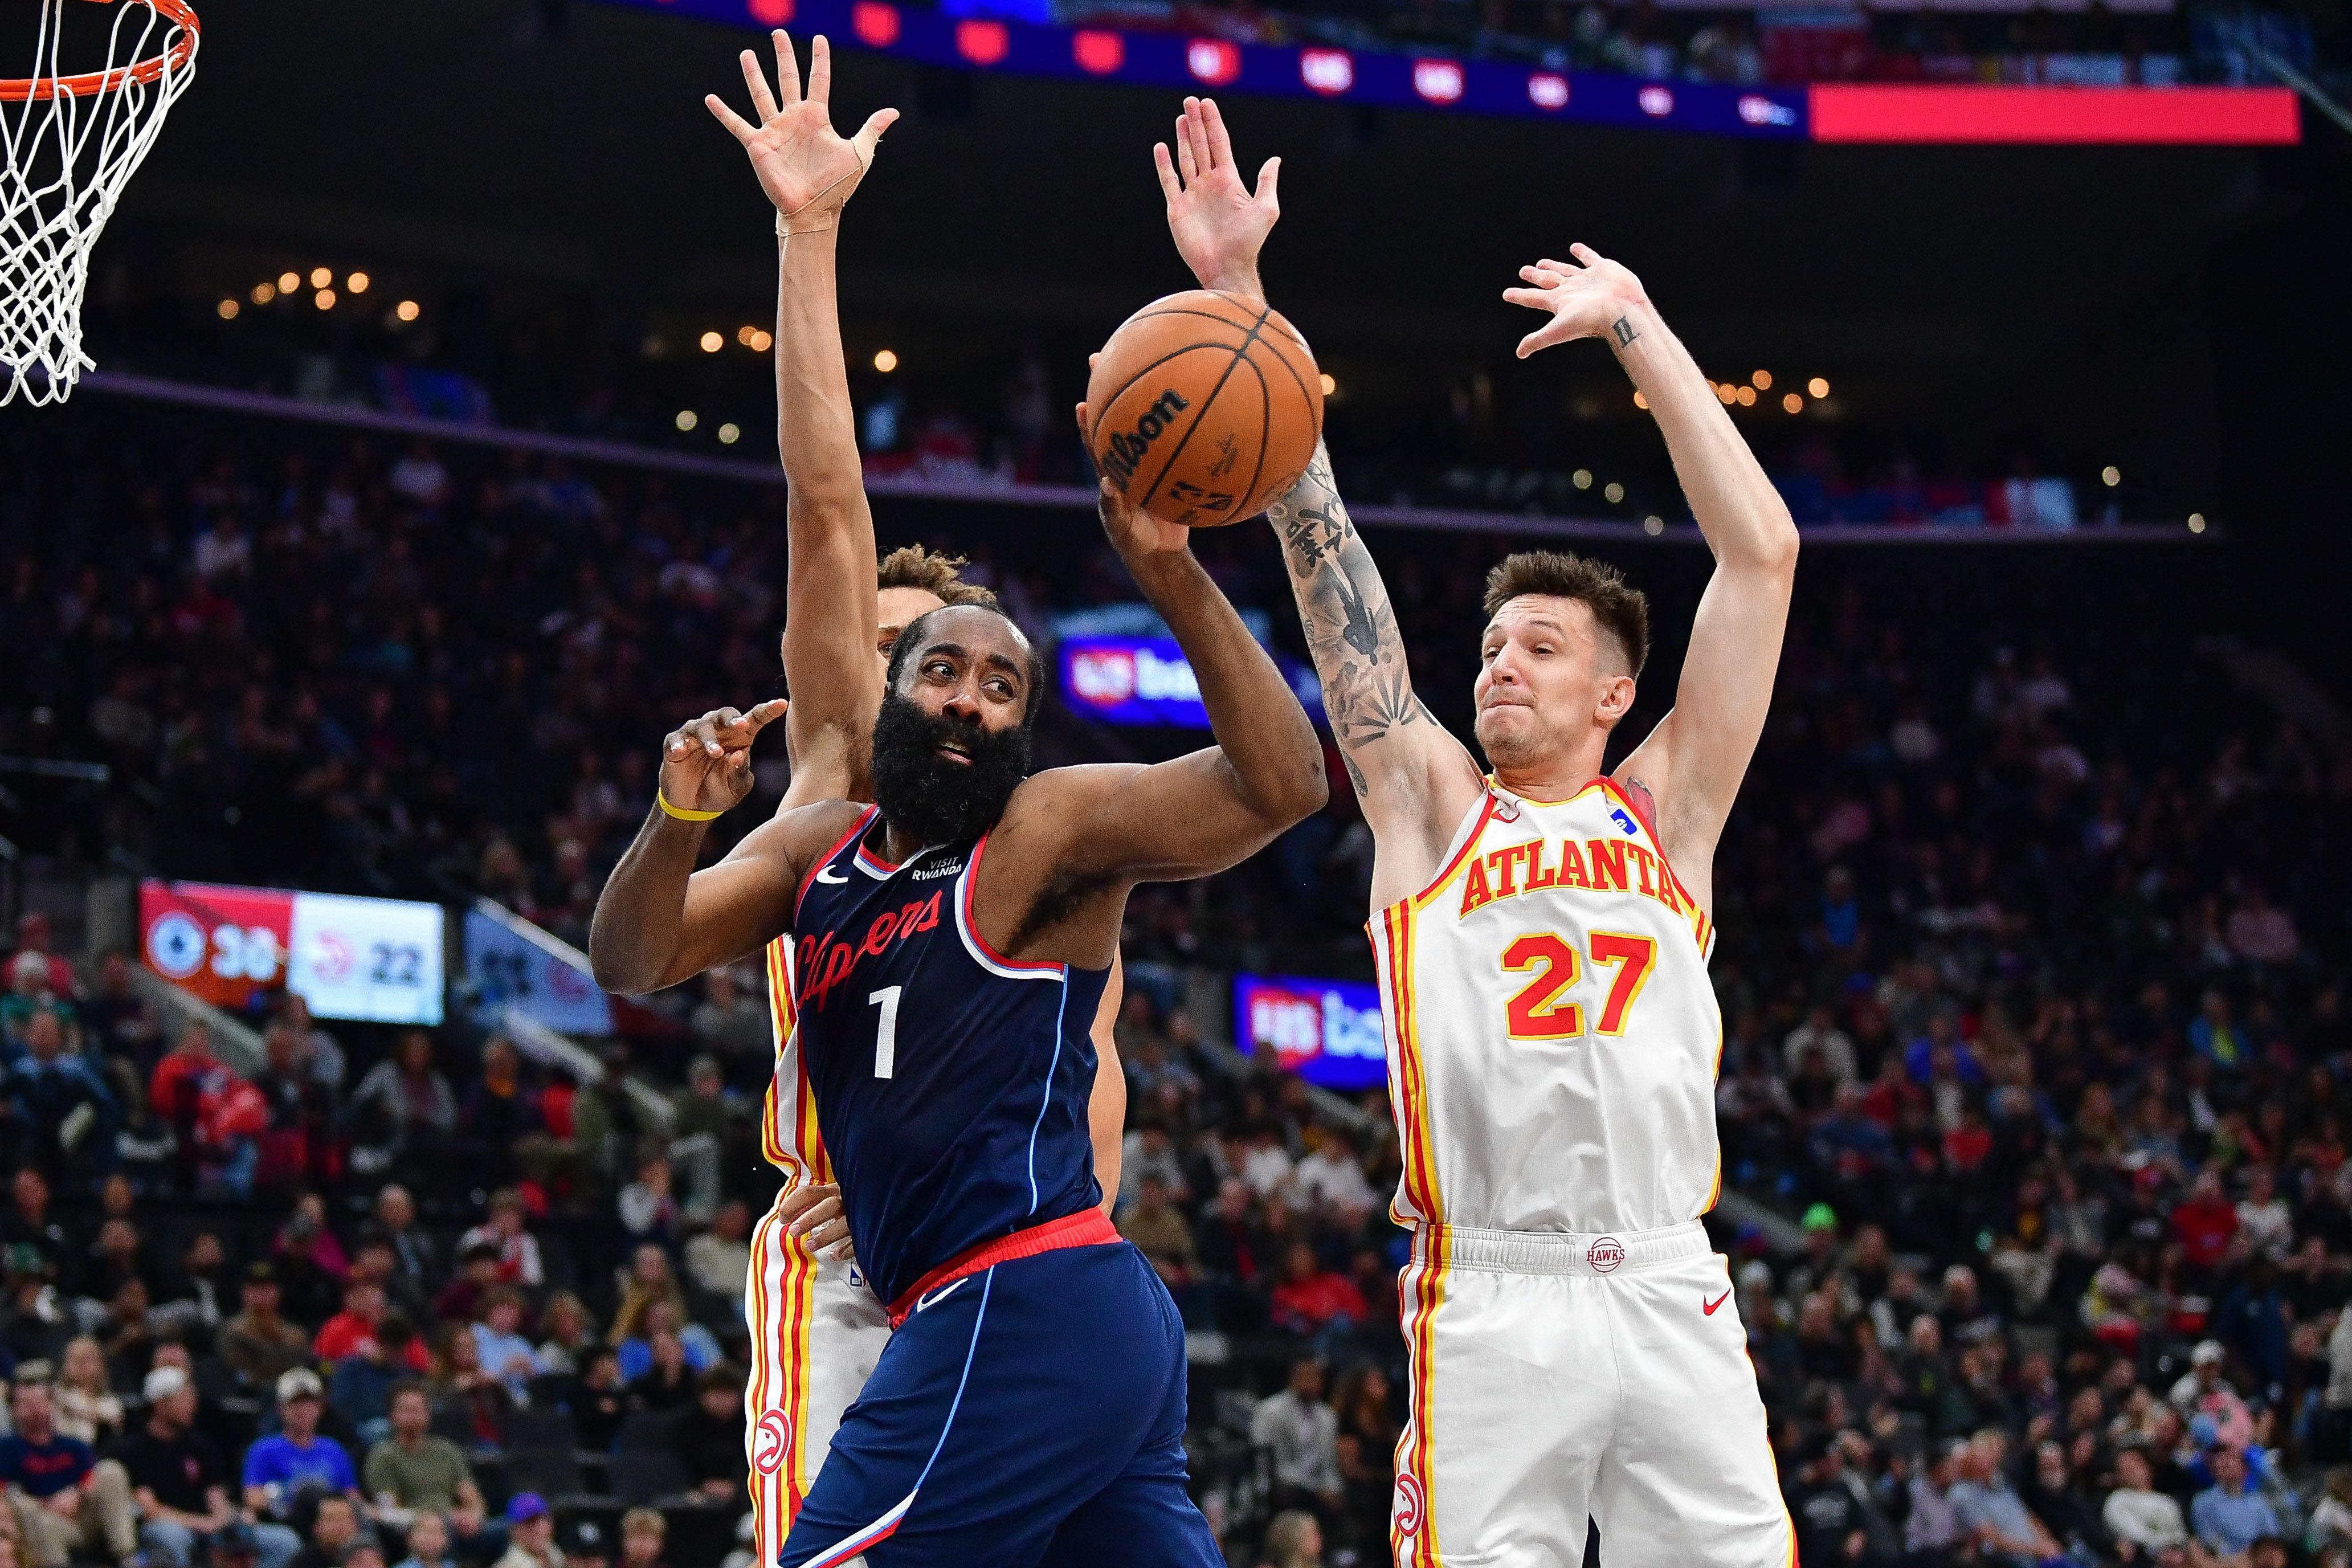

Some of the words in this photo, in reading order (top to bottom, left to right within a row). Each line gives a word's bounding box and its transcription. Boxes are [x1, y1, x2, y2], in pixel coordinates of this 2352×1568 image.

[912, 864, 962, 881] RWANDA
[930, 856, 959, 869] VISIT
[1459, 838, 1684, 920] ATLANTA
[368, 937, 424, 987] 22
[1500, 929, 1657, 1041] 27
[868, 985, 902, 1079] 1
[1586, 1248, 1626, 1261] HAWKS
